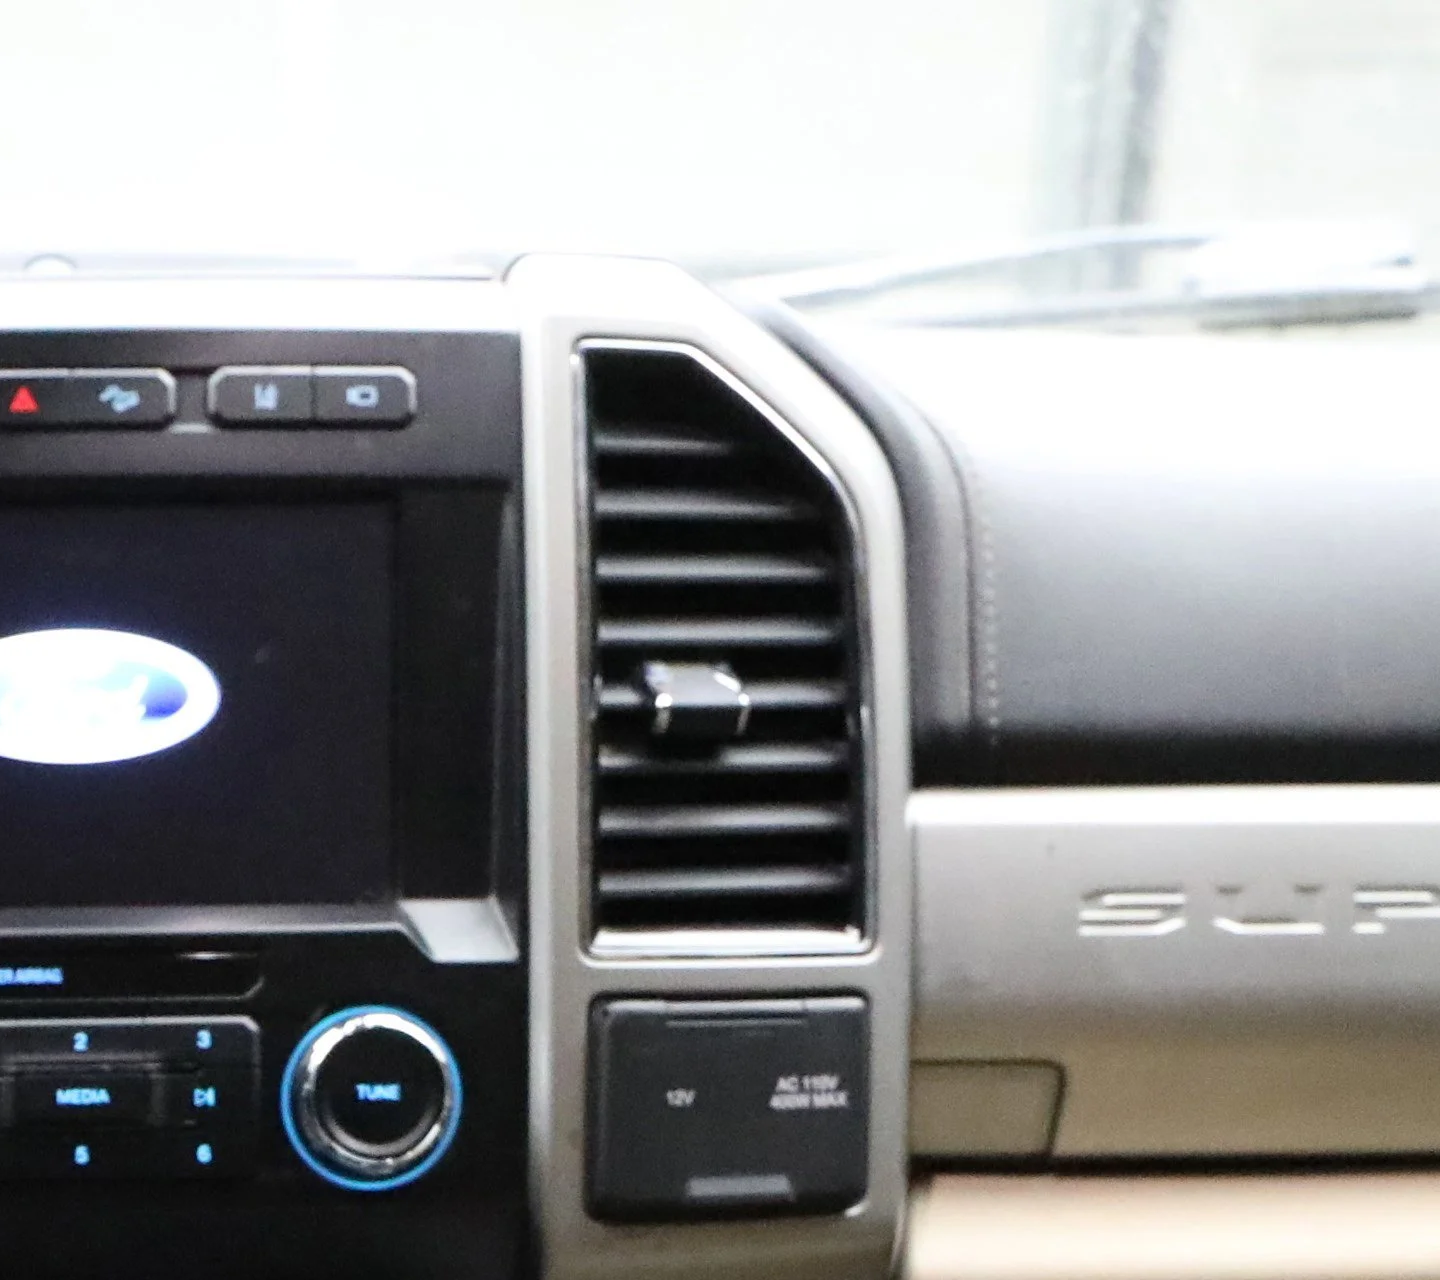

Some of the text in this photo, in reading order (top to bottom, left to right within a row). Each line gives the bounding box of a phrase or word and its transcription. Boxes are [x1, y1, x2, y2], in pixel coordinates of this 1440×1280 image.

[73, 1030, 89, 1052] 2
[195, 1028, 213, 1050] 3
[55, 1086, 111, 1106] MEDIA
[73, 1144, 90, 1166] 5
[195, 1143, 213, 1165] 6
